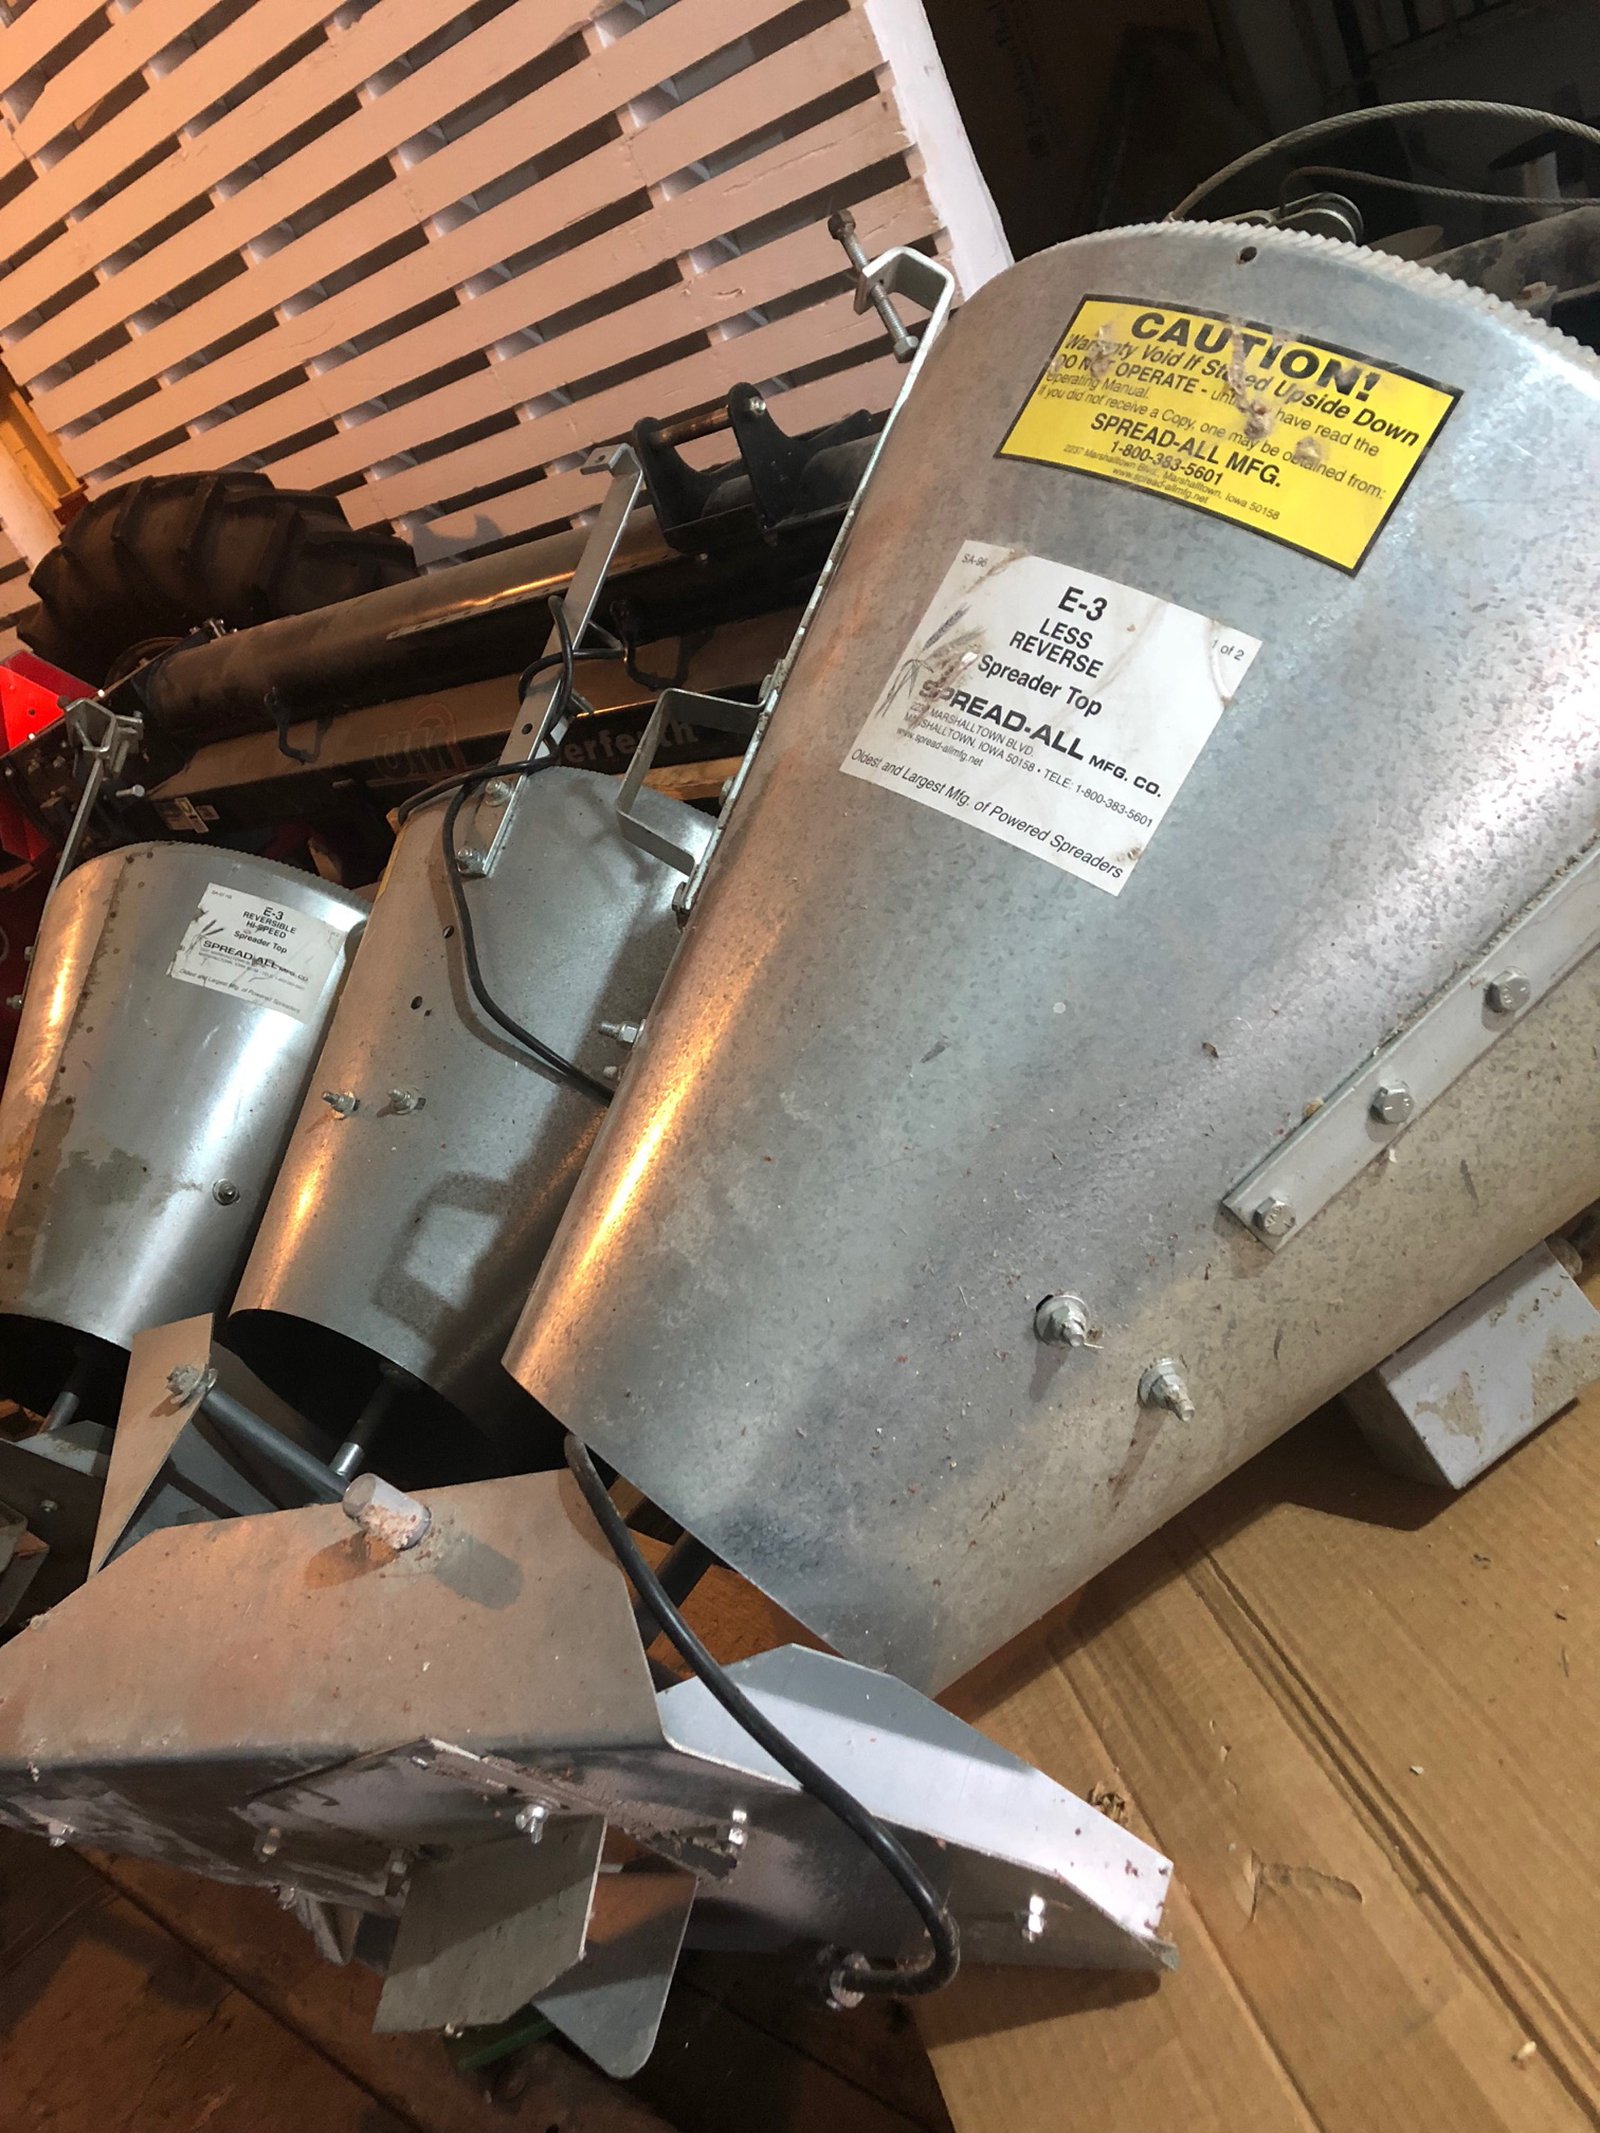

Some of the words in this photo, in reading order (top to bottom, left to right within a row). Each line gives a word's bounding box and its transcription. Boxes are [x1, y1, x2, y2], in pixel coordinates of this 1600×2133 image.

[1131, 312, 1381, 402] CAUTION!
[1046, 372, 1100, 392] Operating
[1102, 377, 1150, 400] Manual.
[1115, 362, 1200, 394] OPERATE
[1276, 408, 1312, 431] have
[1314, 424, 1353, 446] read
[1353, 437, 1379, 457] the
[1142, 344, 1185, 367] Void
[1183, 352, 1204, 372] If
[1201, 359, 1274, 392] Stoed
[1274, 380, 1350, 419] Upside
[1353, 408, 1420, 447] Down
[1044, 388, 1065, 401] you
[1066, 389, 1085, 403] did
[1087, 391, 1104, 406] not
[1105, 397, 1148, 416] receive
[1149, 408, 1159, 419] a
[1161, 408, 1197, 431] Copy,
[1200, 421, 1226, 438] one
[1228, 430, 1260, 451] may
[1260, 440, 1280, 457] be
[1347, 472, 1387, 500] from:
[1090, 412, 1220, 465] SPREAD-ALL
[1225, 451, 1281, 488] MFG.
[1110, 440, 1225, 486] 1-800-383-5601
[1084, 448, 1137, 469] Marshalltown
[1225, 491, 1248, 508] Iowa
[1249, 502, 1281, 520] 50158
[1057, 586, 1108, 622] E-3
[1009, 630, 1104, 678] REVERSE
[1039, 618, 1093, 649] LESS
[1220, 645, 1235, 656] of
[1234, 650, 1245, 661] 2
[977, 654, 1062, 698] Spreader
[1066, 686, 1102, 718] Top
[919, 679, 1084, 761] SPREAD-ALL
[1089, 754, 1128, 782] MFG.
[1133, 775, 1162, 798] CO.
[930, 708, 1006, 744] MARSHALLTOWN
[1005, 737, 1034, 758] BLVD.
[903, 712, 975, 749] MASHALLTOWN,
[978, 740, 1005, 760] IOWA
[1005, 753, 1035, 773] 50158
[1044, 768, 1074, 790] TELE:
[1075, 784, 1154, 828] 1-800-383-5601
[851, 748, 882, 768] Oldest
[881, 762, 904, 777] and
[902, 767, 947, 795] Largest
[945, 785, 970, 808] Mfg.
[974, 800, 990, 814] of
[989, 805, 1051, 842] Powered
[1050, 834, 1124, 879] Spreaders
[233, 930, 270, 947] Spreader
[272, 942, 288, 954] Top
[242, 911, 297, 934] REVERSIBLE
[263, 906, 284, 921] E-3
